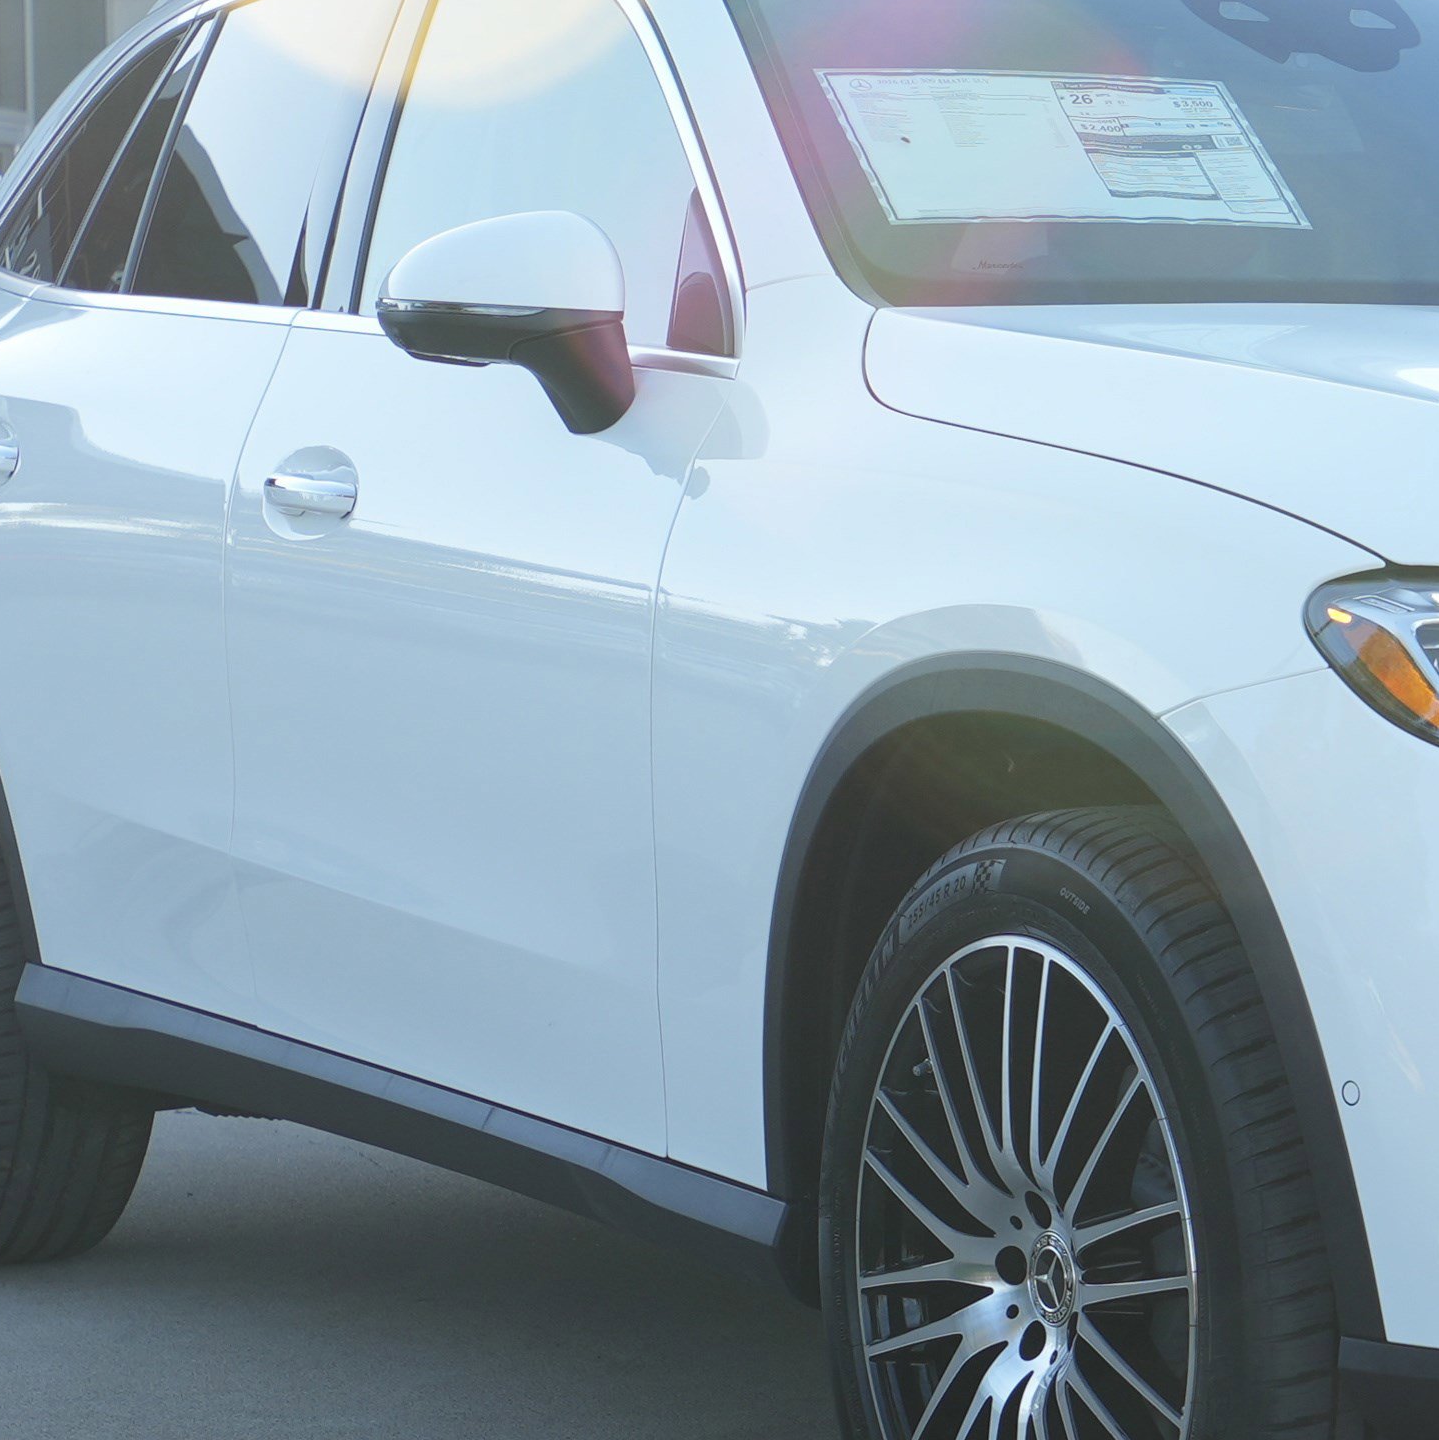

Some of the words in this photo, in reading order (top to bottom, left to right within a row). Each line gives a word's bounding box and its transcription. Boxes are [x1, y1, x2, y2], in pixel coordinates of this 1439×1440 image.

[1069, 93, 1094, 105] 26
[1172, 100, 1214, 109] $3,500
[1079, 122, 1122, 133] $2,400
[953, 875, 967, 893] 20
[1059, 886, 1091, 915] OUTSIDE
